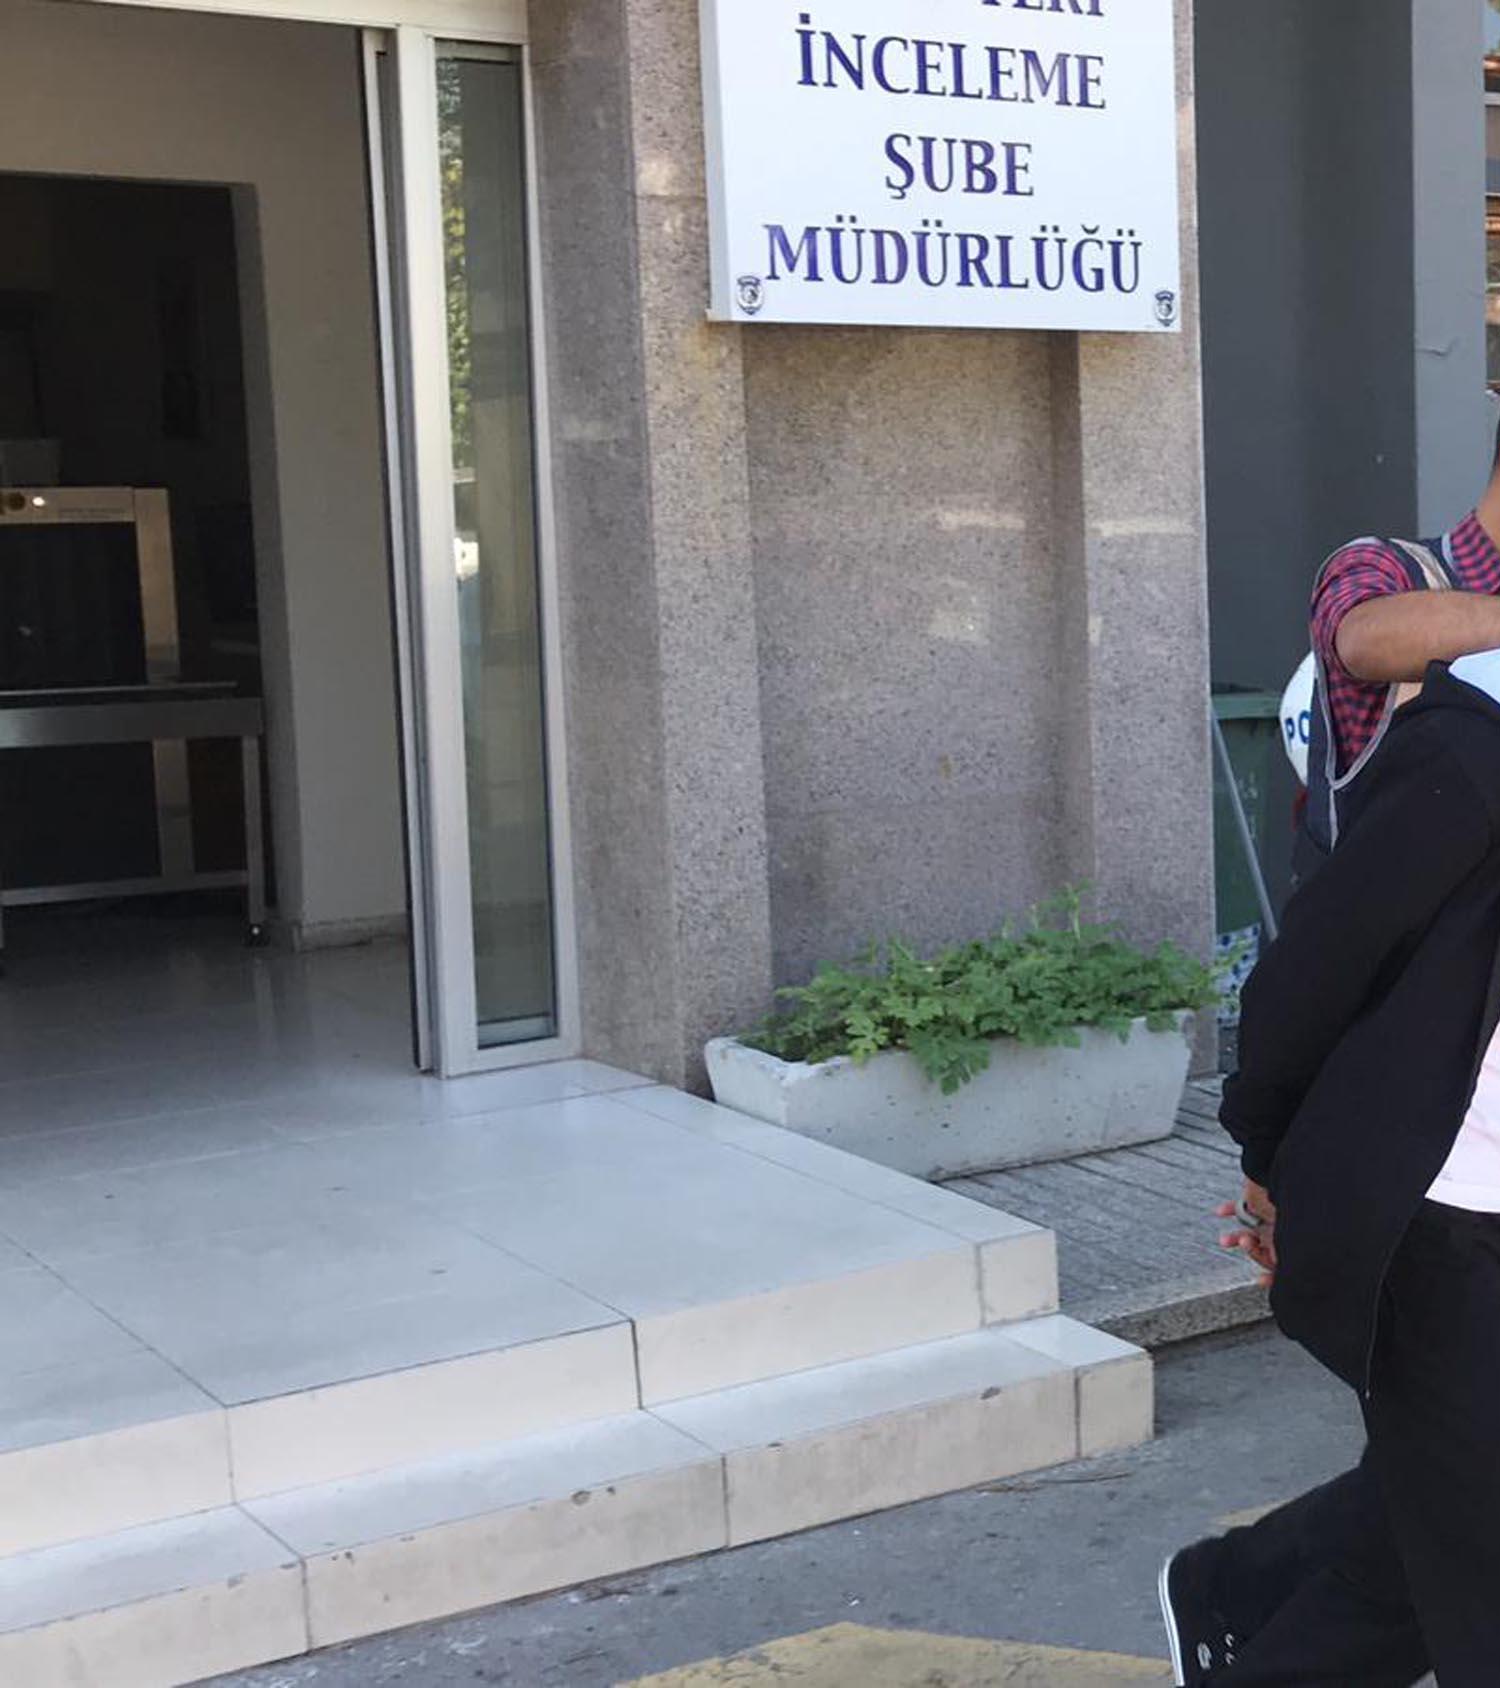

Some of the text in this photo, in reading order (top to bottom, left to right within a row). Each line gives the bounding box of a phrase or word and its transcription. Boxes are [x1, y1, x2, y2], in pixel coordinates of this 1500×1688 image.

[795, 12, 1106, 110] İNCELEME
[884, 133, 1034, 200] ŞUBE
[763, 214, 1143, 294] MÜDÜRLÜĞÜ
